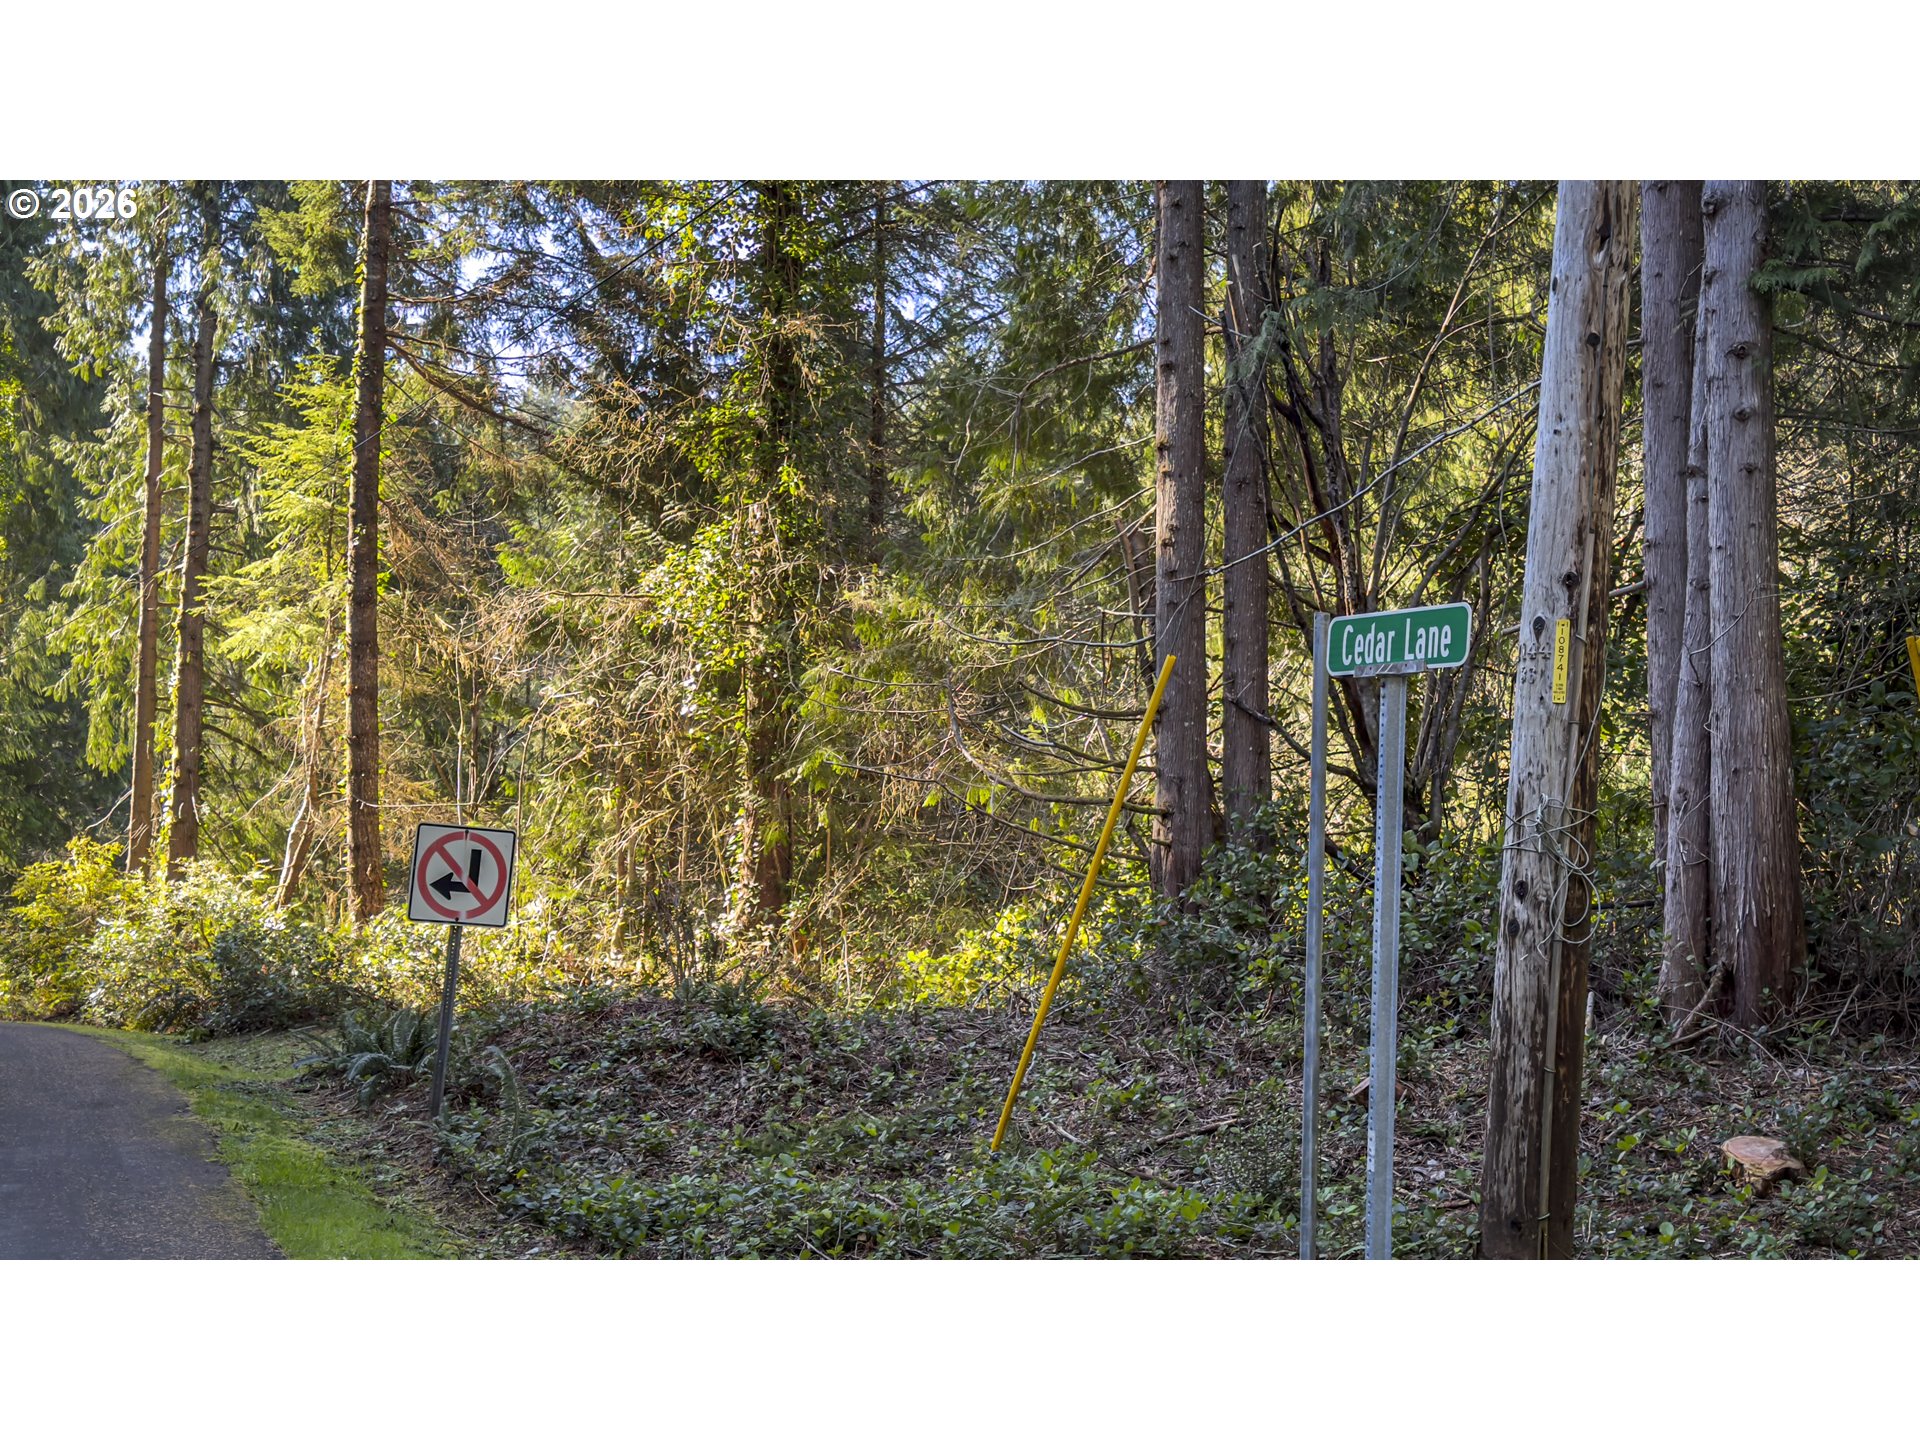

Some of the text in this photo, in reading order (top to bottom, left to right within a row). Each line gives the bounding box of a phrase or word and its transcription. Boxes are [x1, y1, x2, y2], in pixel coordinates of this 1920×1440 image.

[1342, 618, 1452, 666] Cedar Lane
[1556, 627, 1566, 681] 108741
